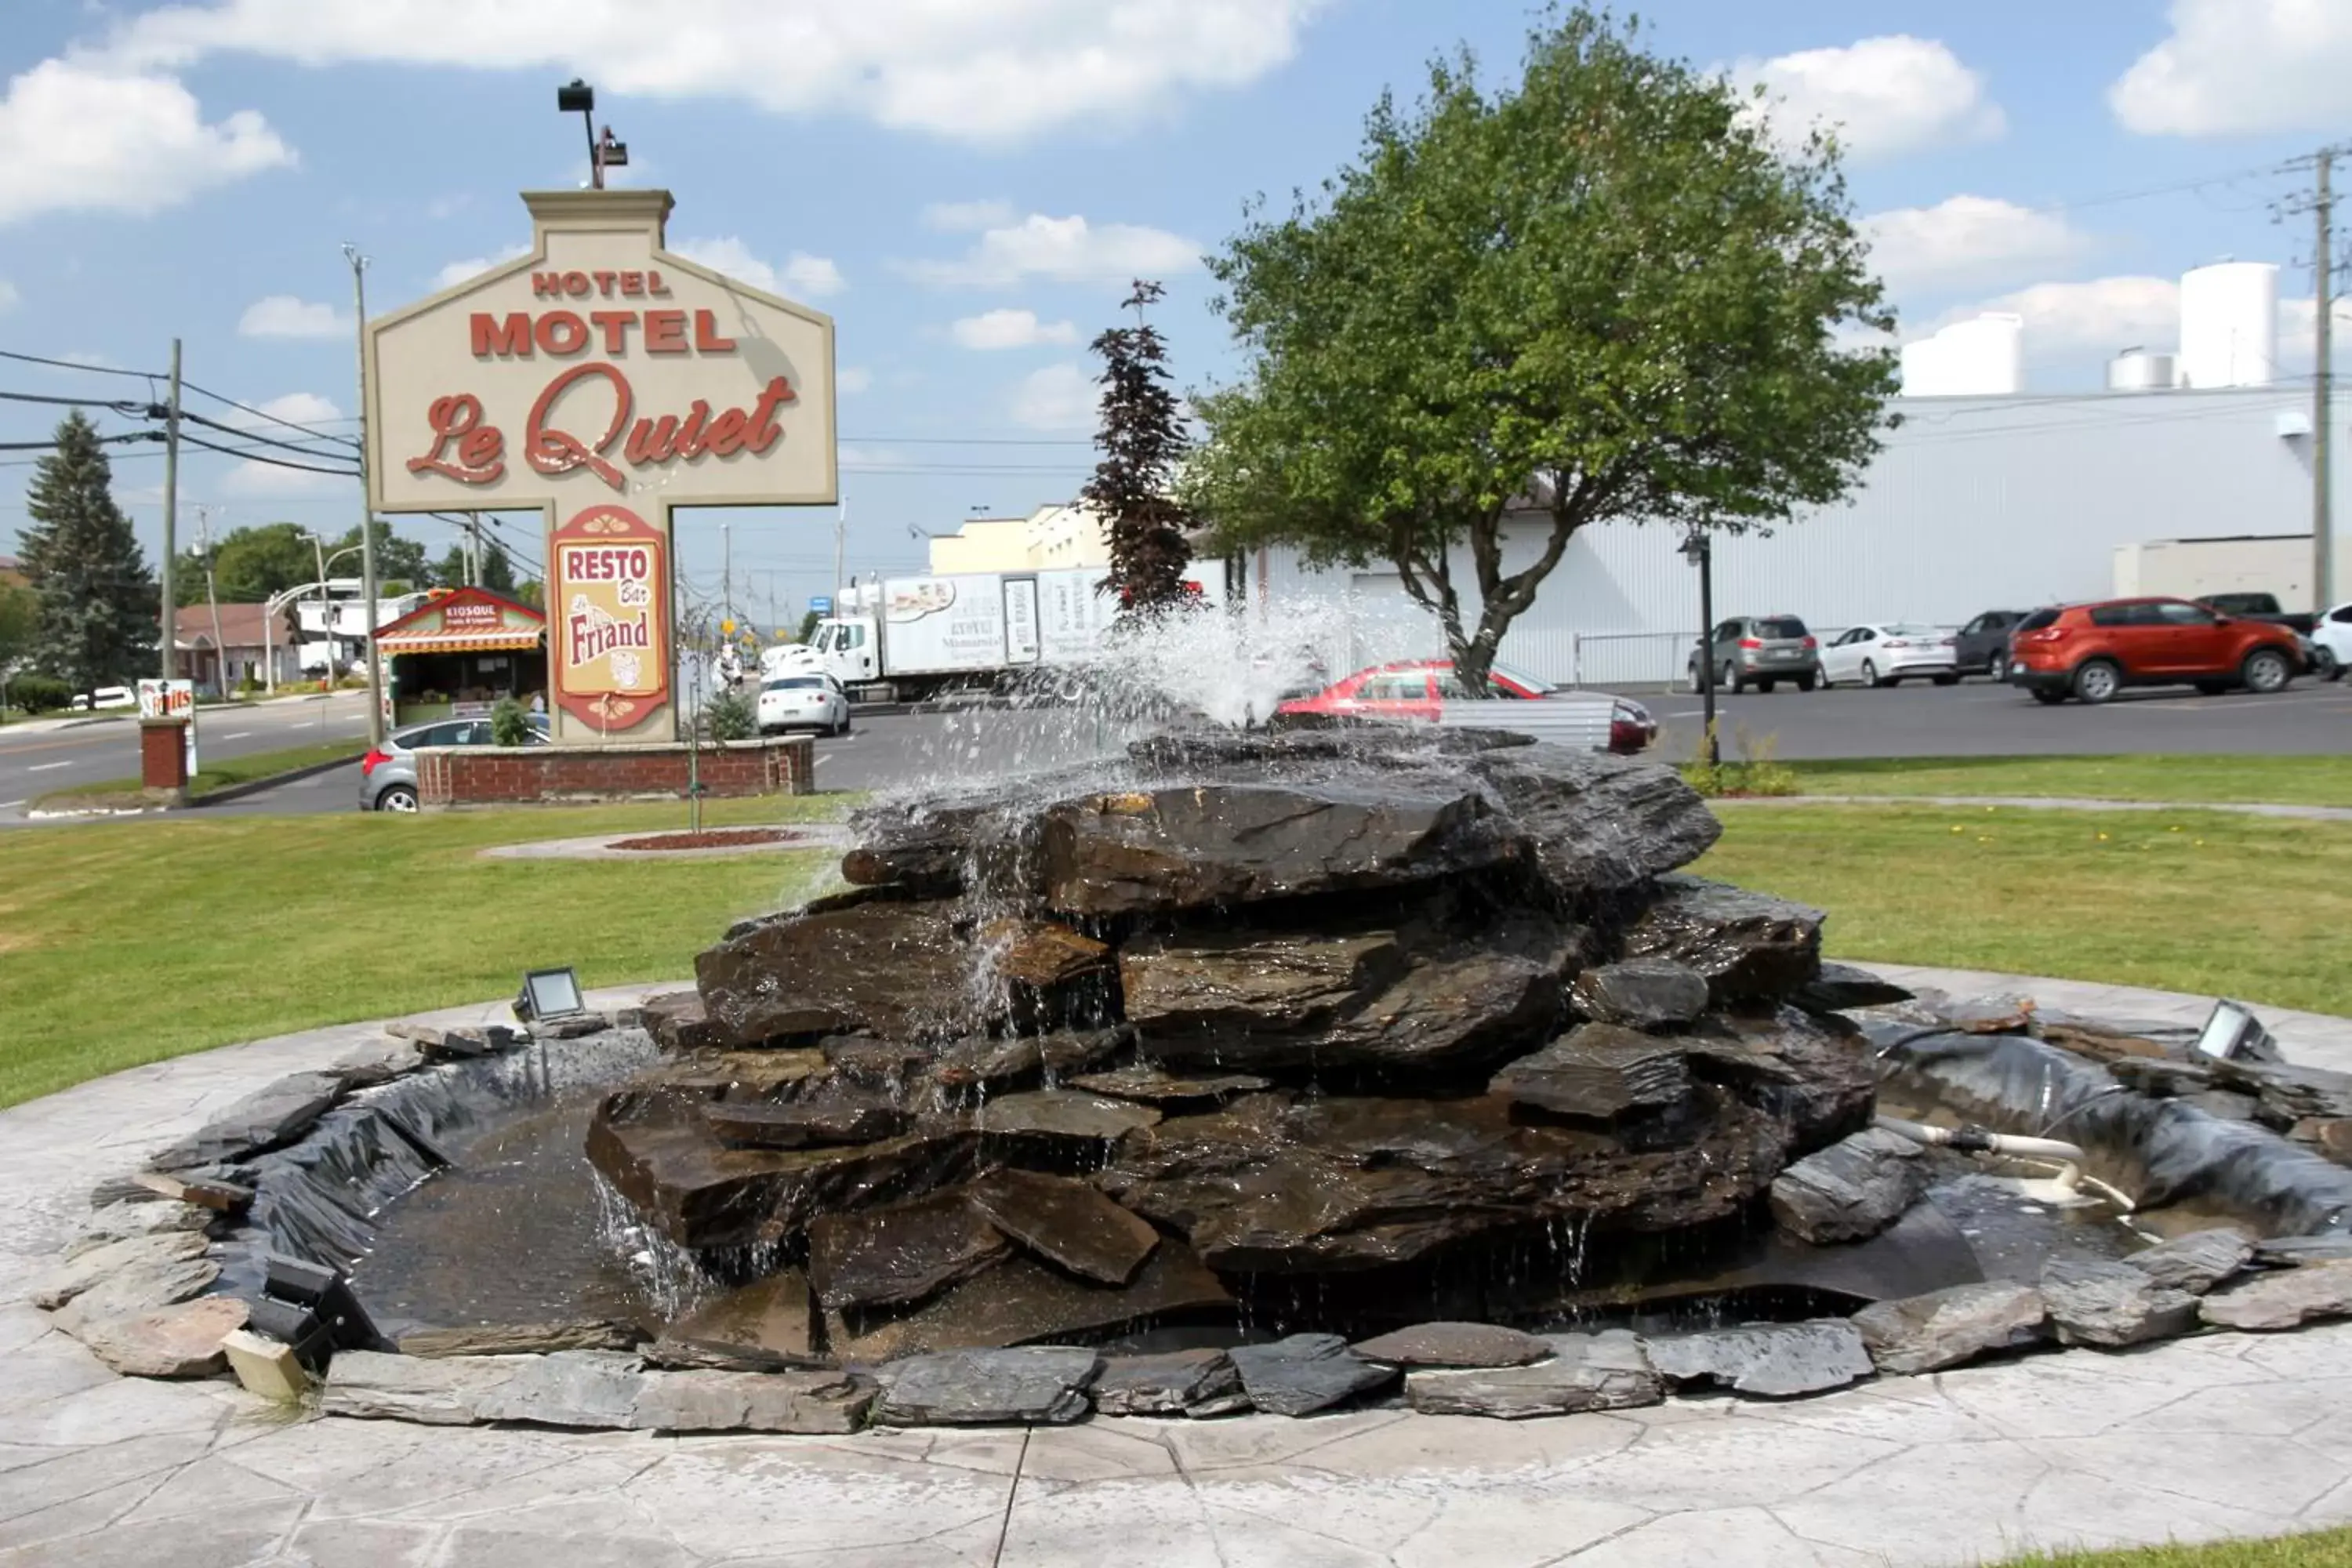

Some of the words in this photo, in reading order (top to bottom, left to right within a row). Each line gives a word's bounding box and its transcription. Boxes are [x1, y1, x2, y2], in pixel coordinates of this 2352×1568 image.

[532, 271, 670, 297] HOTEL
[470, 309, 736, 356] MOTEL
[406, 394, 504, 484] Le
[525, 362, 796, 491] Quiet
[567, 550, 648, 579] RESTO
[620, 579, 648, 603] Bar
[445, 604, 495, 616] KIOSQUE
[571, 612, 648, 665] Friand
